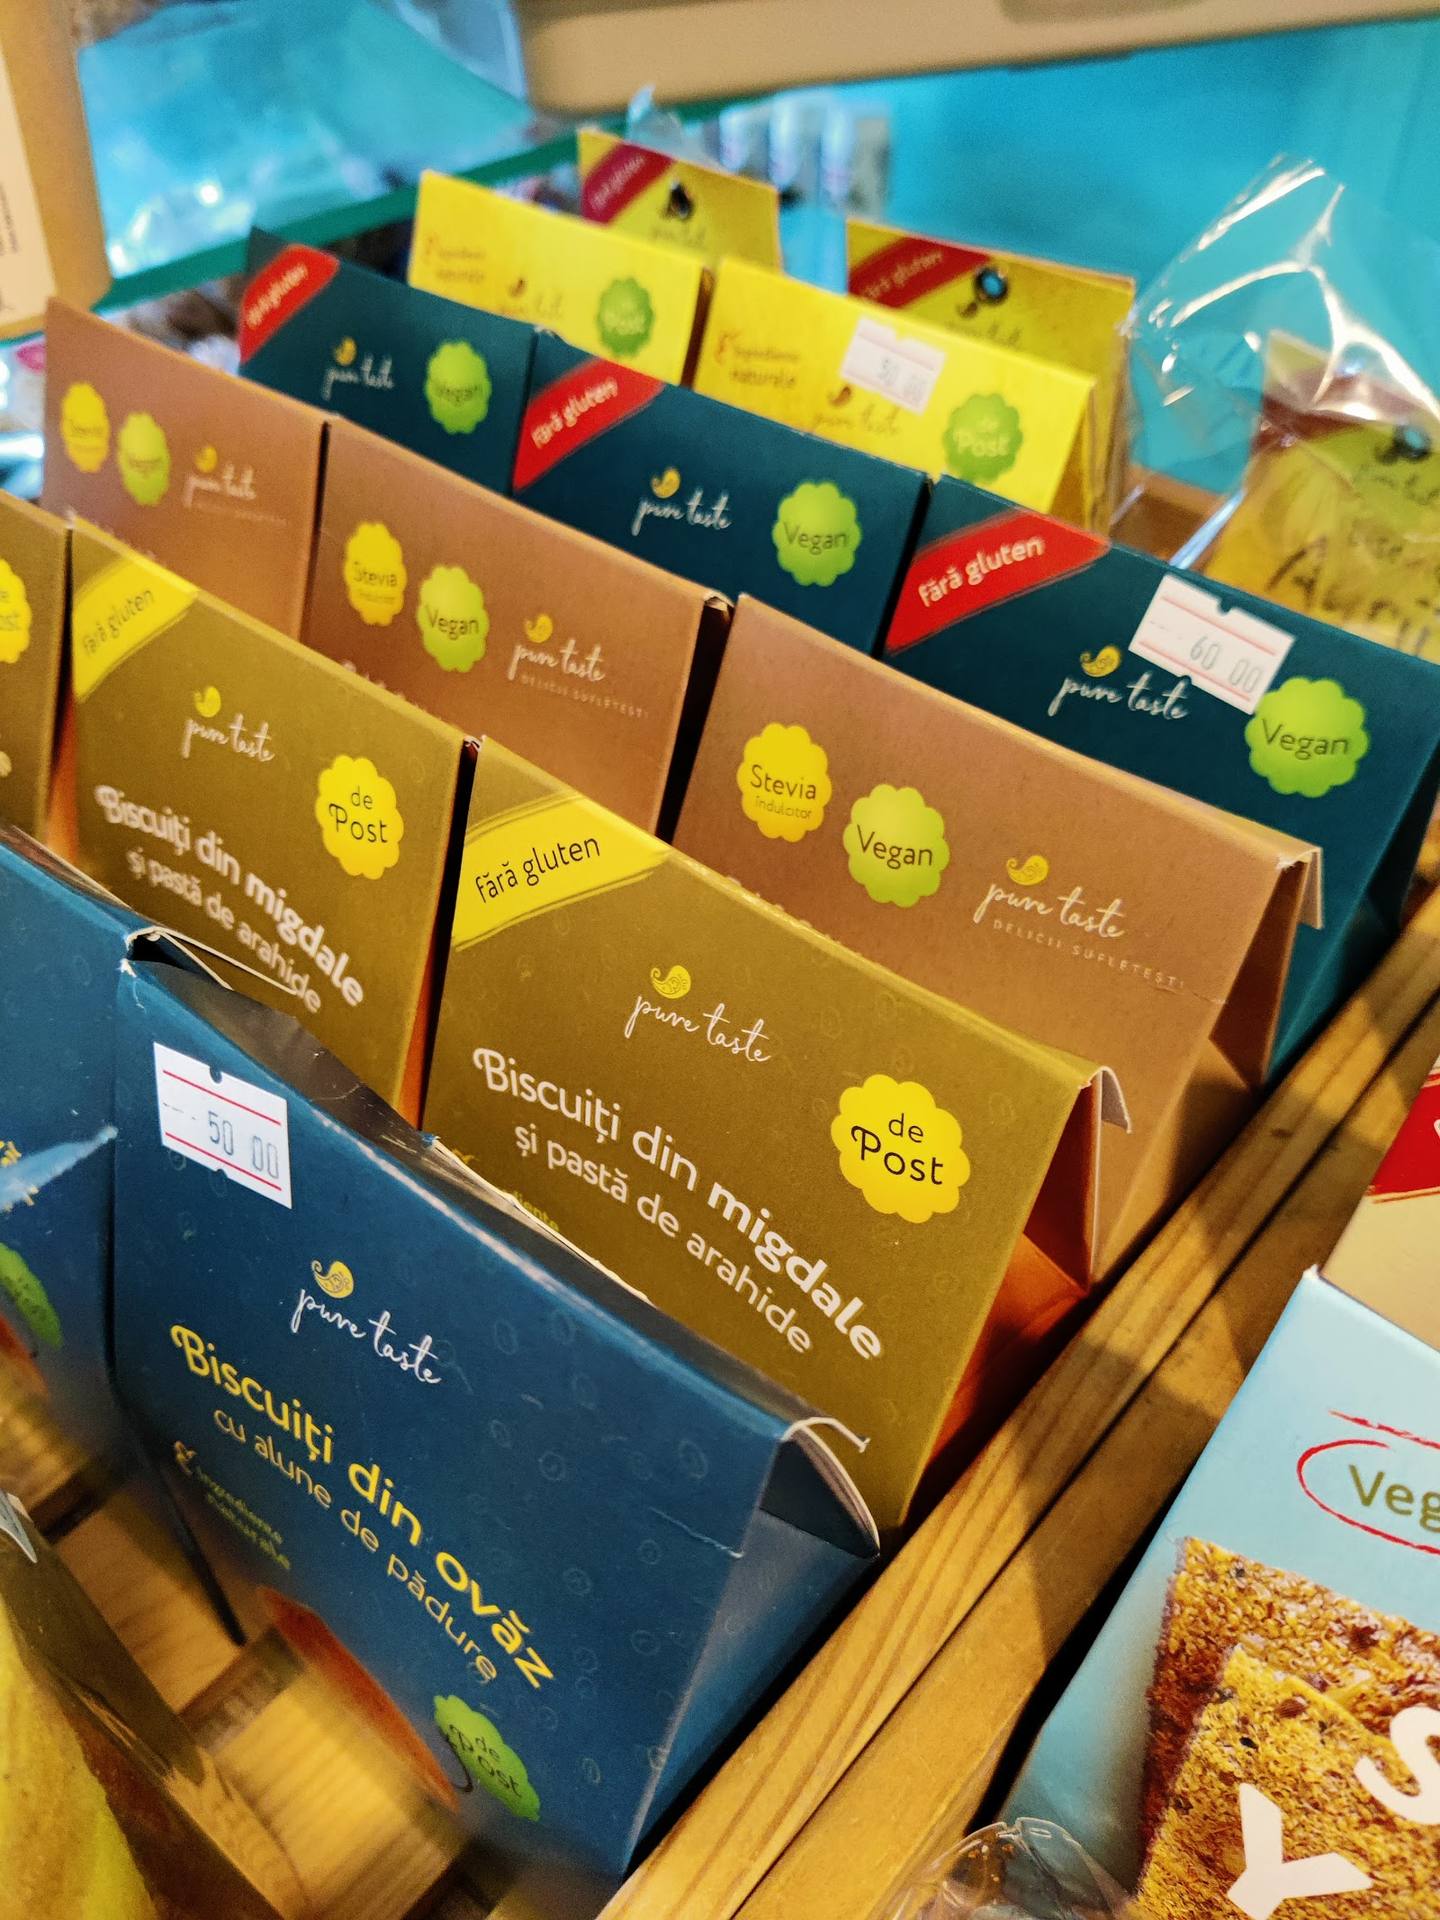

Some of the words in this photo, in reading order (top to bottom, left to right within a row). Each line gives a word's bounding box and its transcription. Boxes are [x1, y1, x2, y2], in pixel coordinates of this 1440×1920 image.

[782, 520, 849, 556] Vegan
[918, 563, 963, 608] fără
[964, 535, 1047, 586] gluten
[425, 602, 480, 641] Vegan
[559, 638, 606, 682] taste
[1189, 635, 1220, 671] 60
[1229, 657, 1263, 694] 00
[1047, 676, 1123, 717] pure
[1126, 671, 1191, 720] taste
[229, 711, 277, 764] taste
[1260, 717, 1350, 761] Vegan
[350, 784, 374, 811] de
[749, 762, 818, 801] Stevia
[328, 802, 388, 844] Post
[856, 823, 934, 870] Vegan
[474, 860, 519, 904] fără
[522, 836, 601, 887] gluten
[195, 829, 242, 886] din
[244, 872, 365, 1006] migdale
[973, 883, 1054, 924] pure
[1057, 885, 1126, 938] taste
[993, 918, 1063, 950] DELICII
[204, 890, 236, 929] de
[237, 916, 322, 1014] arahide
[623, 994, 700, 1039] pure
[698, 1000, 772, 1063] taste
[208, 1109, 235, 1157] 50
[251, 1135, 280, 1180] 00
[850, 1124, 945, 1187] Post
[887, 1112, 925, 1144] de
[472, 1046, 621, 1144] Biscuiți
[632, 1122, 698, 1192] din
[706, 1180, 883, 1360] migdale
[514, 1122, 538, 1157] și
[546, 1136, 629, 1203] pastă
[636, 1190, 681, 1240] de
[685, 1233, 812, 1355] arahide
[291, 1287, 366, 1338] pure
[367, 1309, 442, 1385] taste
[170, 1324, 334, 1466] Biscuiți
[347, 1460, 422, 1547] din
[434, 1551, 555, 1690] ovăz
[213, 1407, 247, 1445] cu
[253, 1431, 334, 1510] alune
[339, 1507, 381, 1553] de
[387, 1553, 499, 1684] pădure
